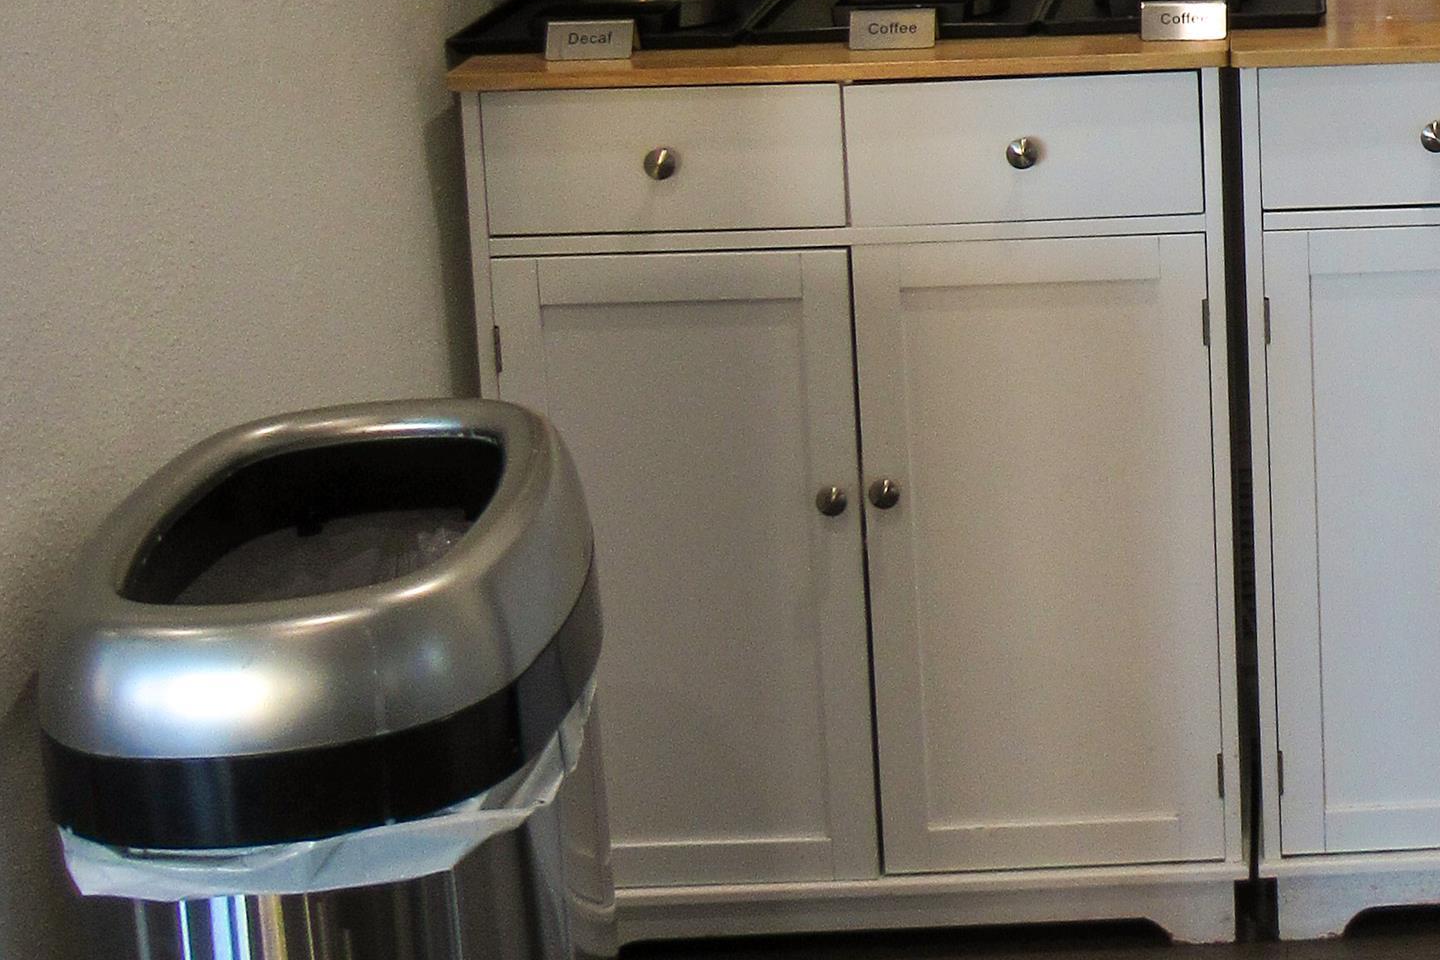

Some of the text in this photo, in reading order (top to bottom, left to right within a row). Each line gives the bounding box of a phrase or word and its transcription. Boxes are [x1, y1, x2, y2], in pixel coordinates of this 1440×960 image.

[1160, 12, 1209, 25] Coffe
[868, 22, 917, 35] Coffee
[568, 31, 612, 45] Decaf
